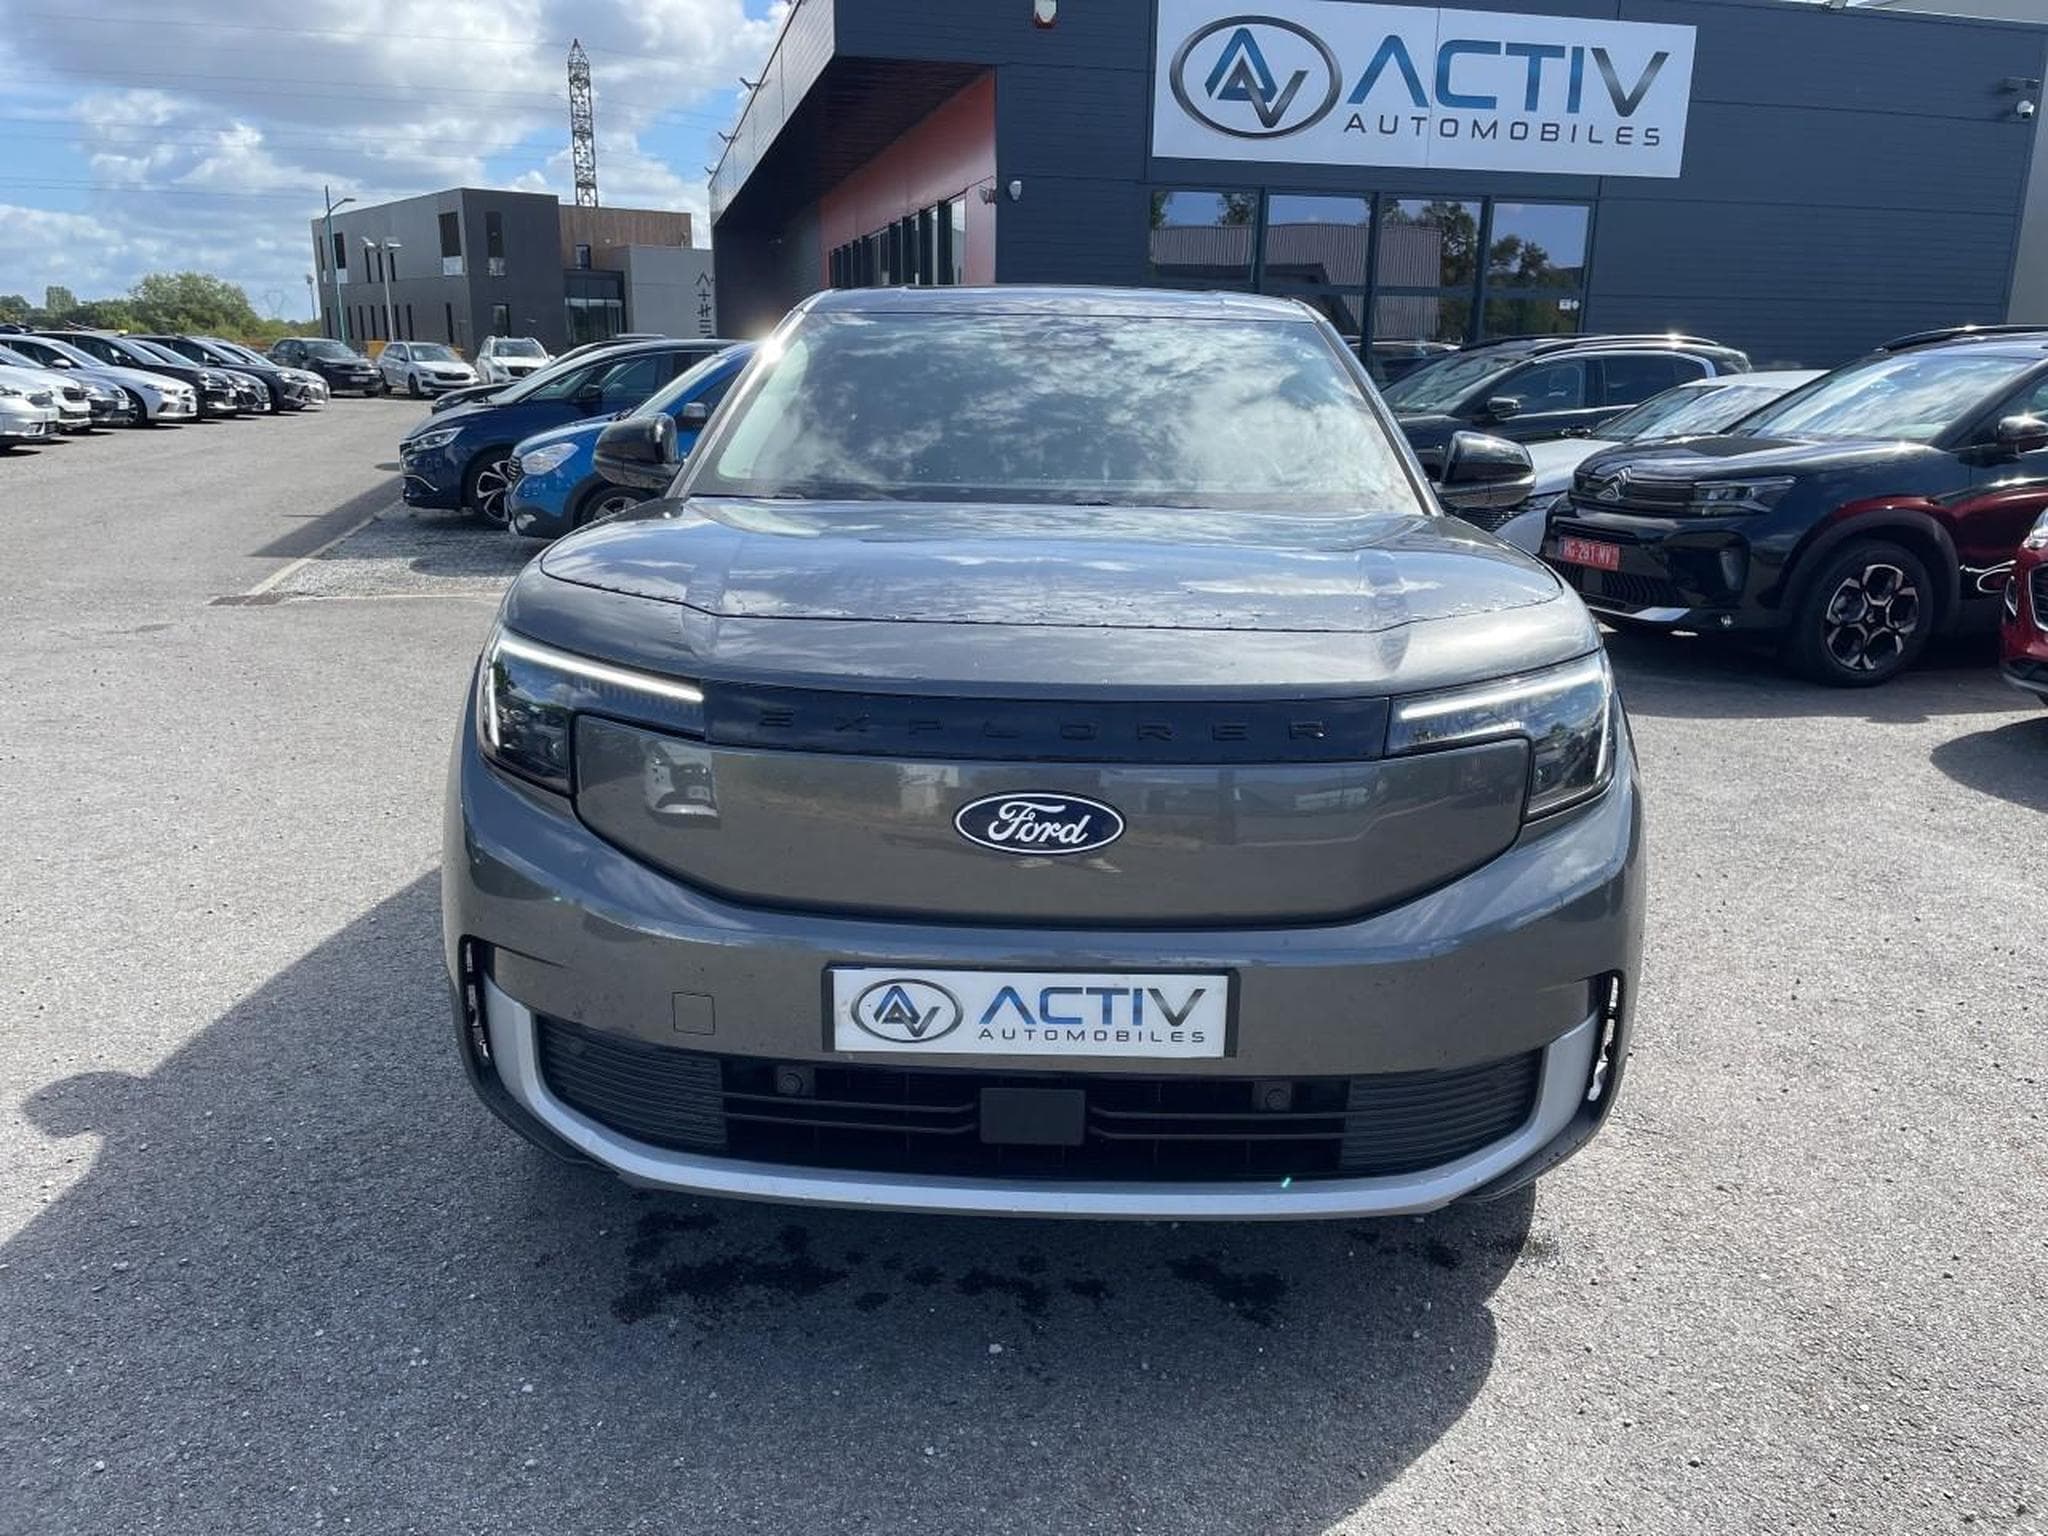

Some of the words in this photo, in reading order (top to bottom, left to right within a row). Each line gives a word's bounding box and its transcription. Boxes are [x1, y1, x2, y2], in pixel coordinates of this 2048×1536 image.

[1347, 34, 1669, 118] ACTIV
[1343, 113, 1661, 147] AUTOMOBILES
[758, 708, 1326, 743] EXPLORER
[988, 801, 1088, 845] Ford
[978, 985, 1206, 1027] ACTIV
[978, 1028, 1206, 1043] AUTOMOBILES
